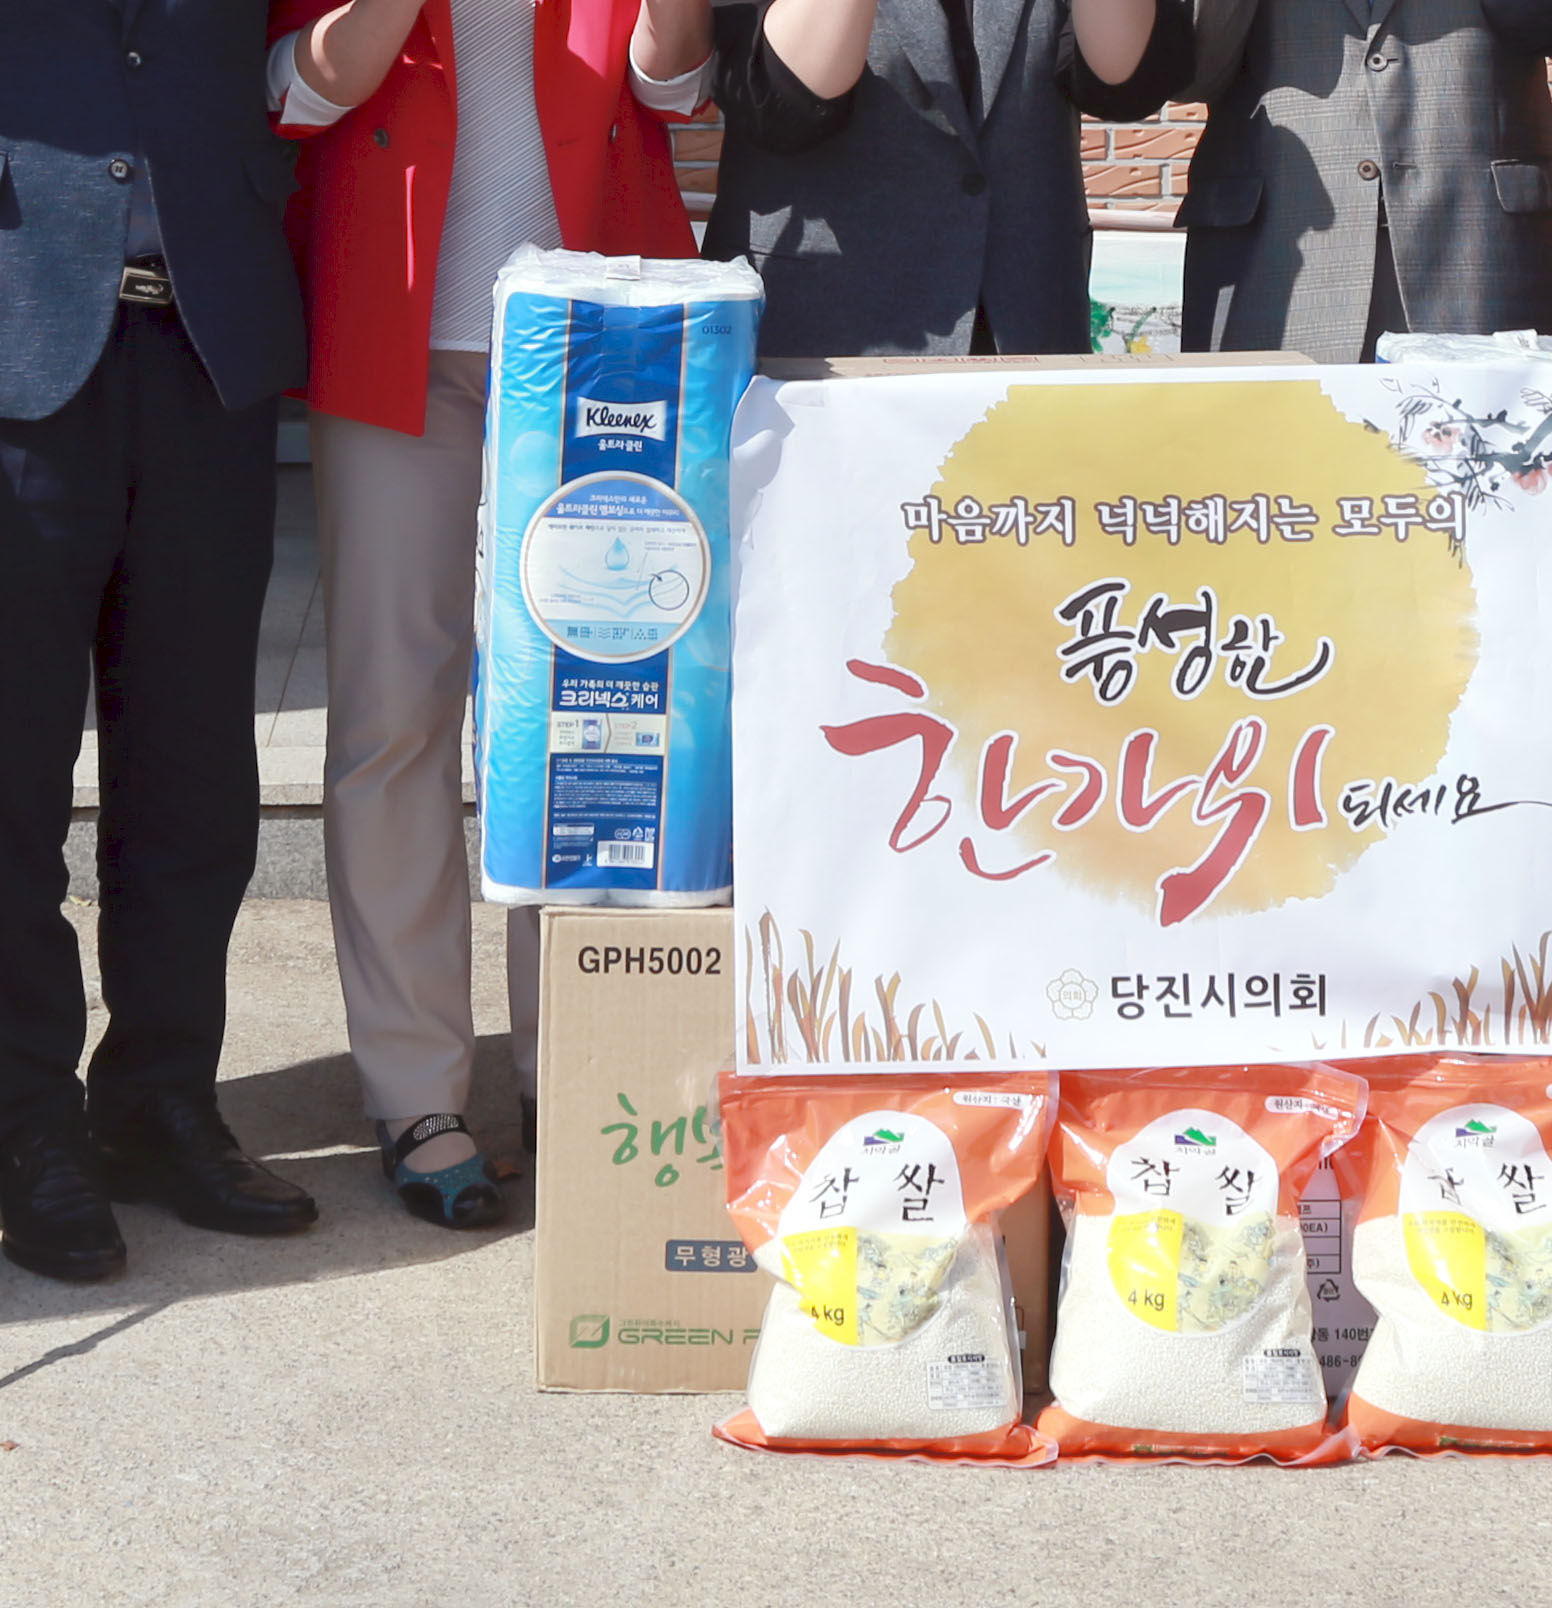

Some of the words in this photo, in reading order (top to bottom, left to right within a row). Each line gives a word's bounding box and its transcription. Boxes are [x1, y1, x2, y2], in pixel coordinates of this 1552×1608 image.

[586, 406, 657, 433] Kleenex
[903, 494, 1076, 546] 마음까지
[1096, 494, 1319, 546] 넉넉해지는
[1332, 493, 1468, 543] 모두의
[1059, 582, 1330, 701] 풍성한
[559, 690, 629, 708] 크리넥스
[631, 693, 659, 709] 케어
[820, 659, 1335, 927] 한가위
[578, 945, 722, 976] GPH5002
[1111, 972, 1326, 1020] 당진시의회
[674, 1245, 748, 1268] 무형광
[1128, 1288, 1137, 1306] 4
[1144, 1287, 1165, 1312] kg
[1452, 1290, 1473, 1311] kg
[823, 1304, 845, 1326] kg
[618, 1328, 734, 1345] GREEN
[1335, 1327, 1374, 1341] 140번
[1319, 1354, 1362, 1368] 486-8
